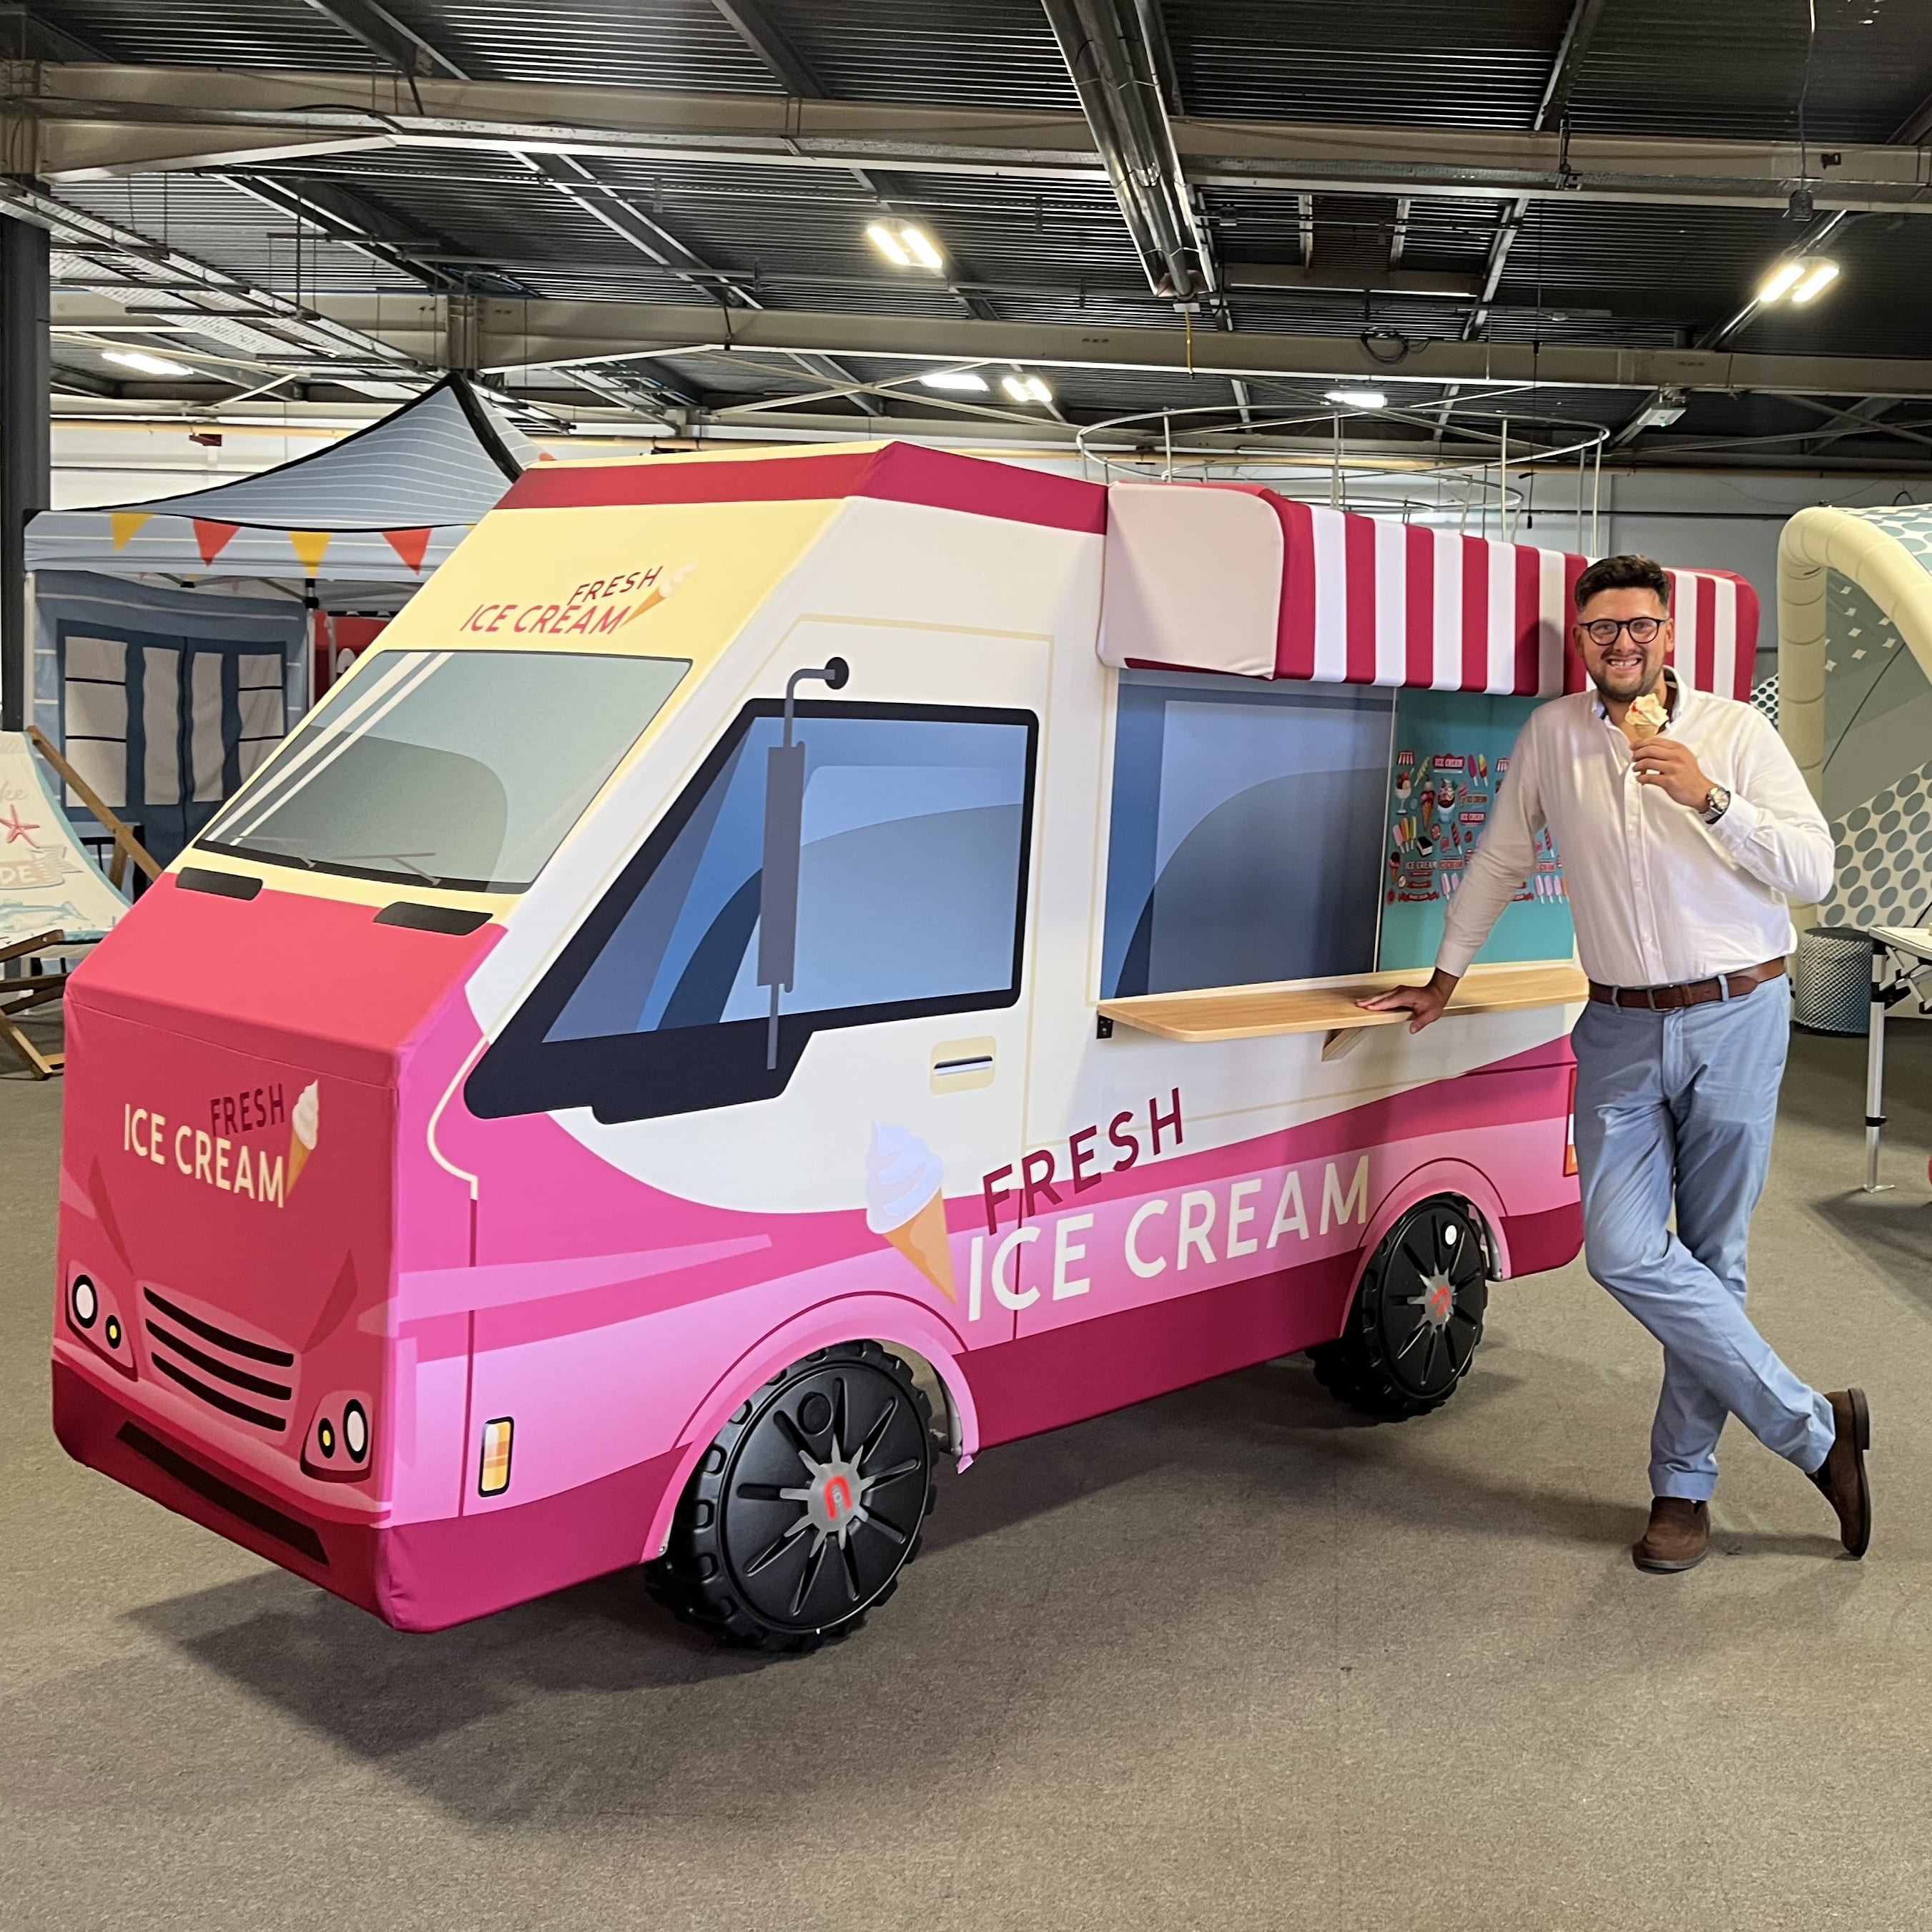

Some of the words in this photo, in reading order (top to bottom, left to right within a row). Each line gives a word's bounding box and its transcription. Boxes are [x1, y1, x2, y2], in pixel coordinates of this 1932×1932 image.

[459, 604, 518, 632] ICE
[514, 605, 631, 634] CREAM
[567, 566, 664, 606] FRESH
[210, 1083, 285, 1137] FRESH
[124, 1103, 165, 1165] ICE
[174, 1125, 284, 1208] CREAM
[982, 1087, 1183, 1236] FRESH
[968, 1213, 1094, 1321] ICE
[1124, 1155, 1369, 1278] CREAM
